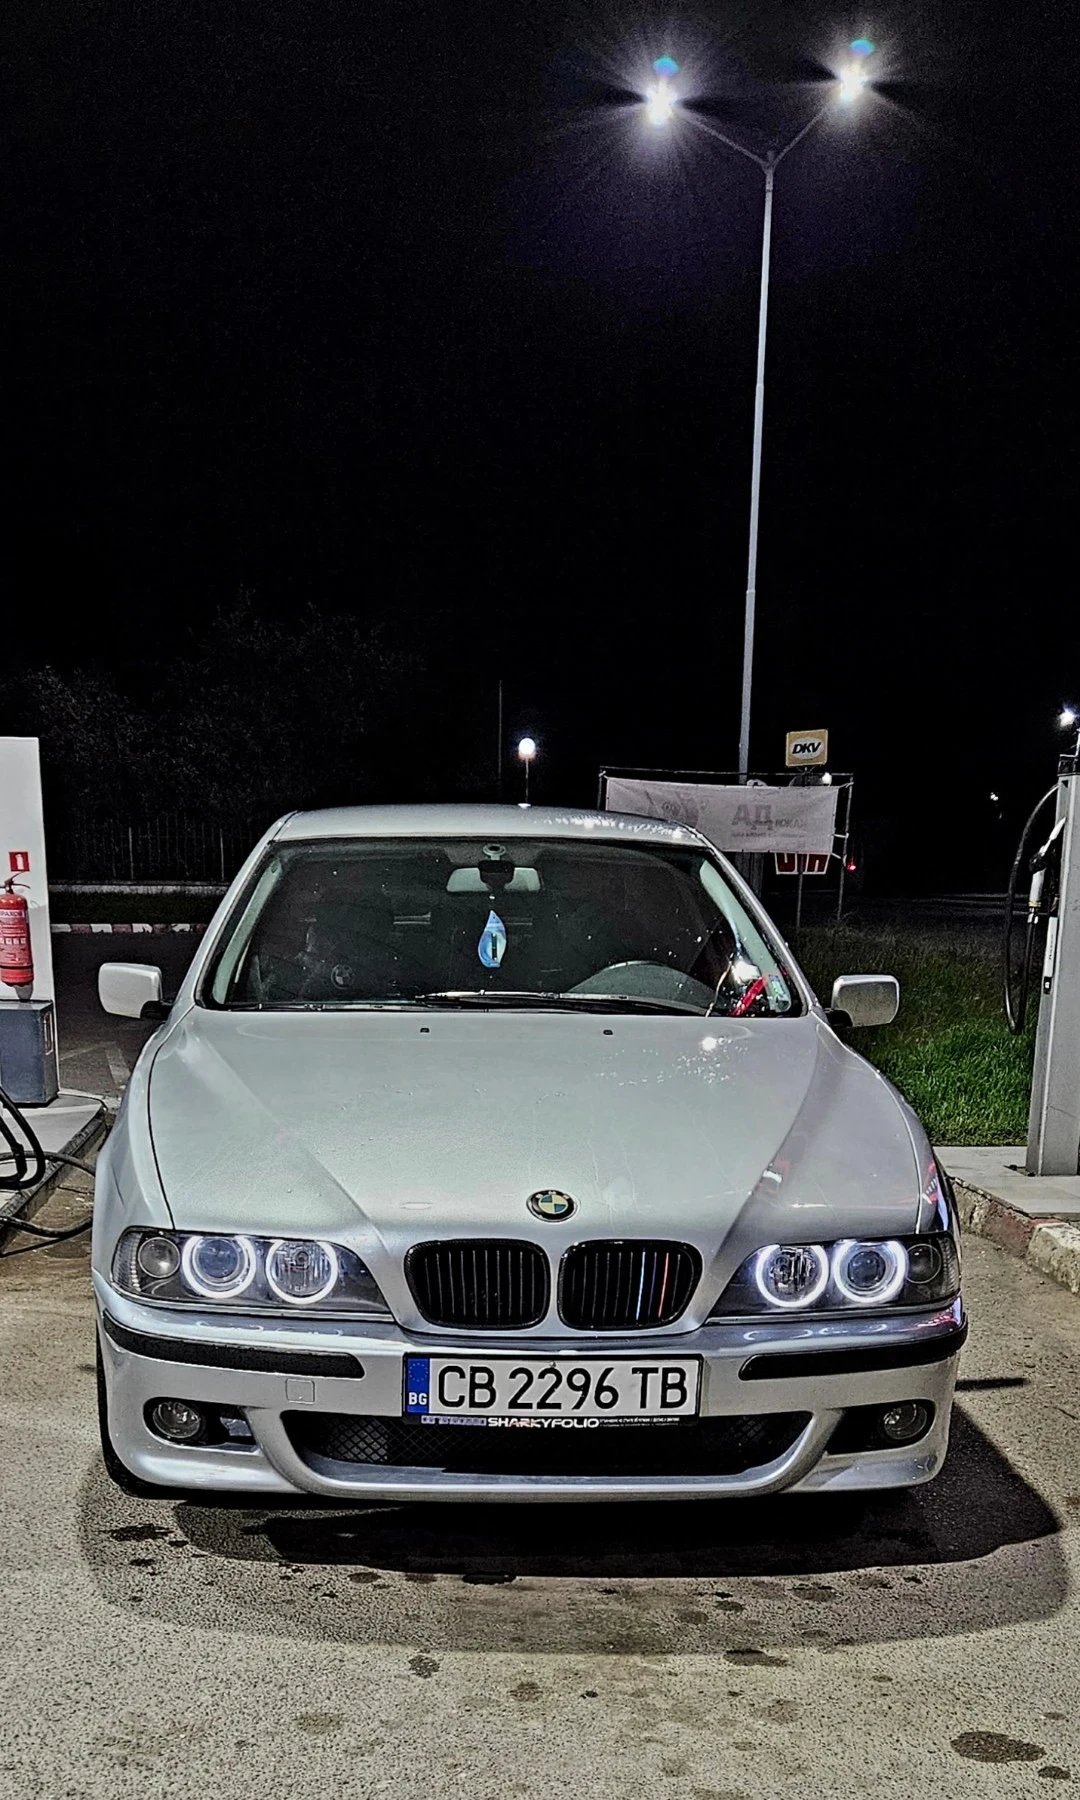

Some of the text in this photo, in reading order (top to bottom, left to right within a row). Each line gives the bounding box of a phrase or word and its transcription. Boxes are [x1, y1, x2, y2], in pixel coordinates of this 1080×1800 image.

[792, 741, 822, 754] DKV
[438, 1365, 688, 1411] CB 2296 TB
[408, 1392, 428, 1405] BG
[488, 1417, 600, 1429] SHARKYFOLIO
